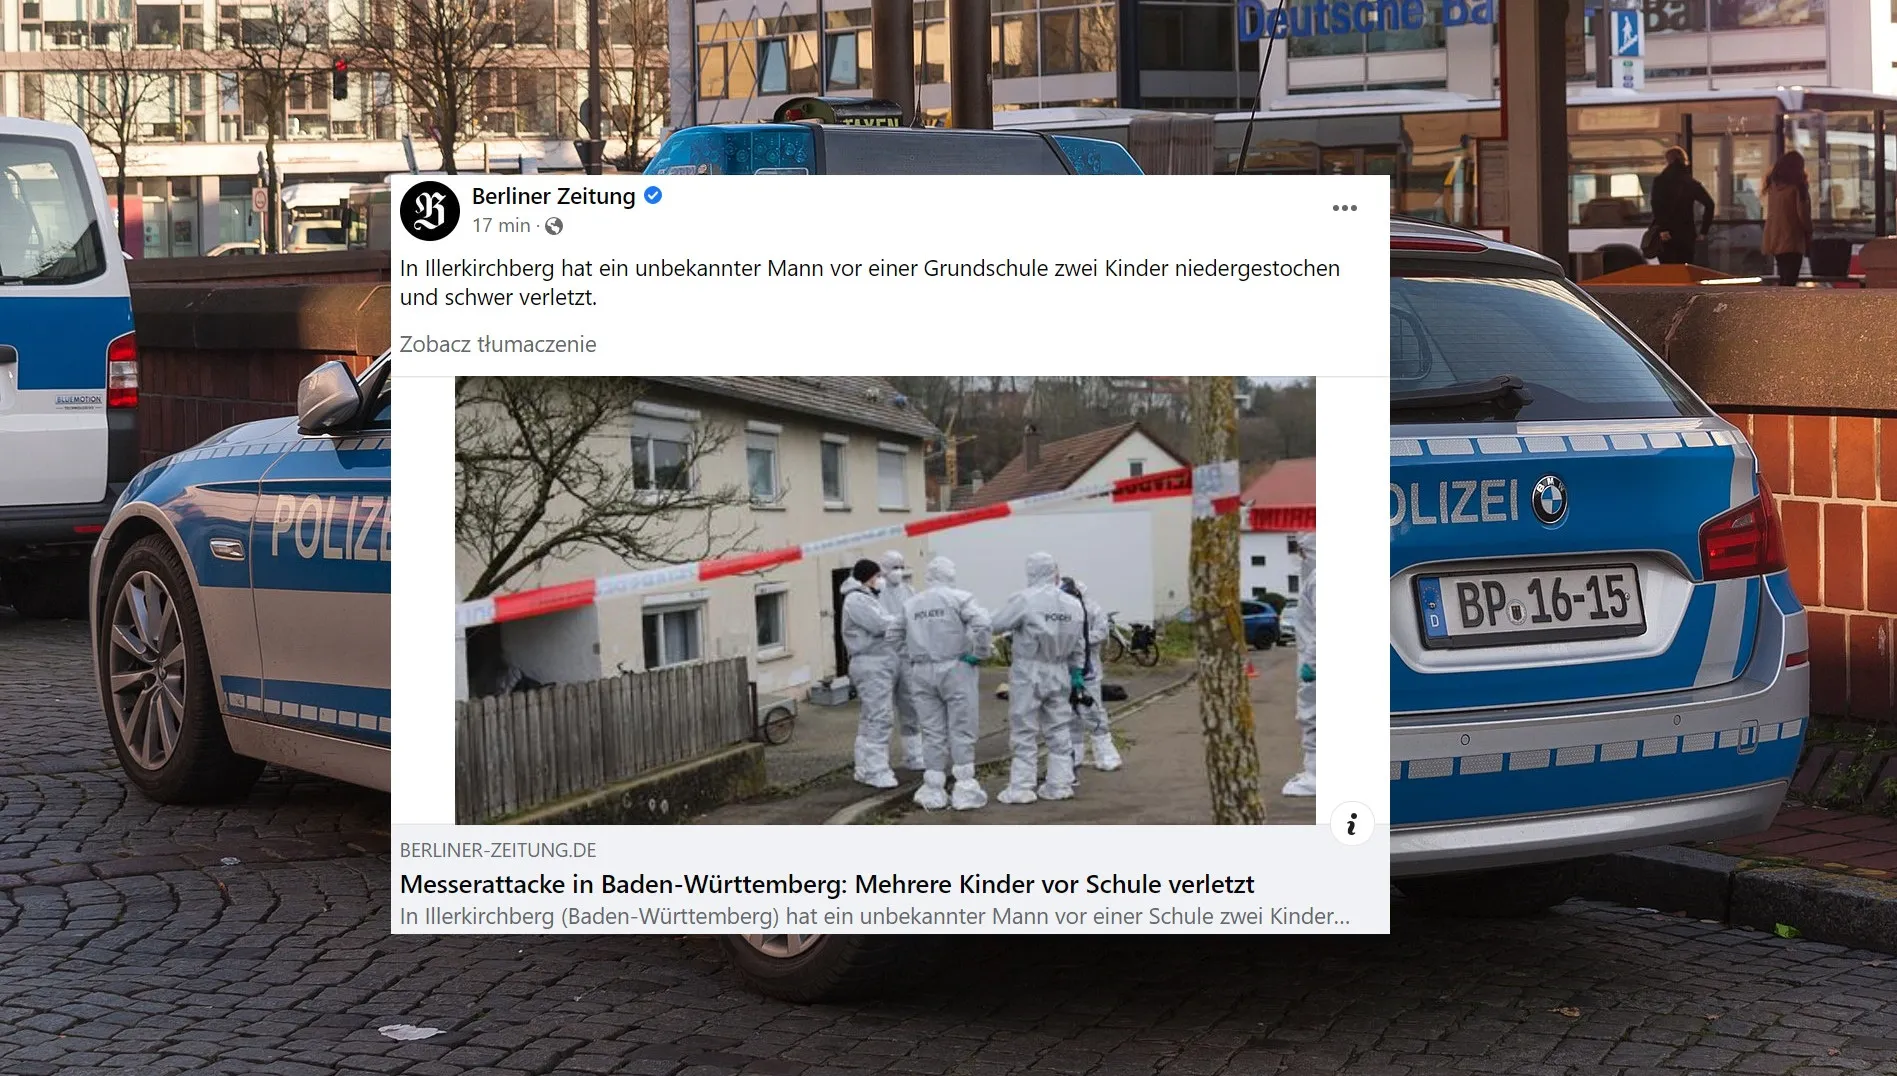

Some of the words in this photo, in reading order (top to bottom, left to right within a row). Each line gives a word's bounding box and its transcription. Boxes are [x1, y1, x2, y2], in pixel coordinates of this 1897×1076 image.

[1238, 0, 1425, 42] Deutsche
[1444, 0, 1495, 27] Ba
[1390, 478, 1519, 526] OLIZEI
[271, 494, 391, 561] POLIZE
[1429, 614, 1440, 628] D
[1456, 580, 1506, 628] BP
[1527, 574, 1629, 624] 16-15
